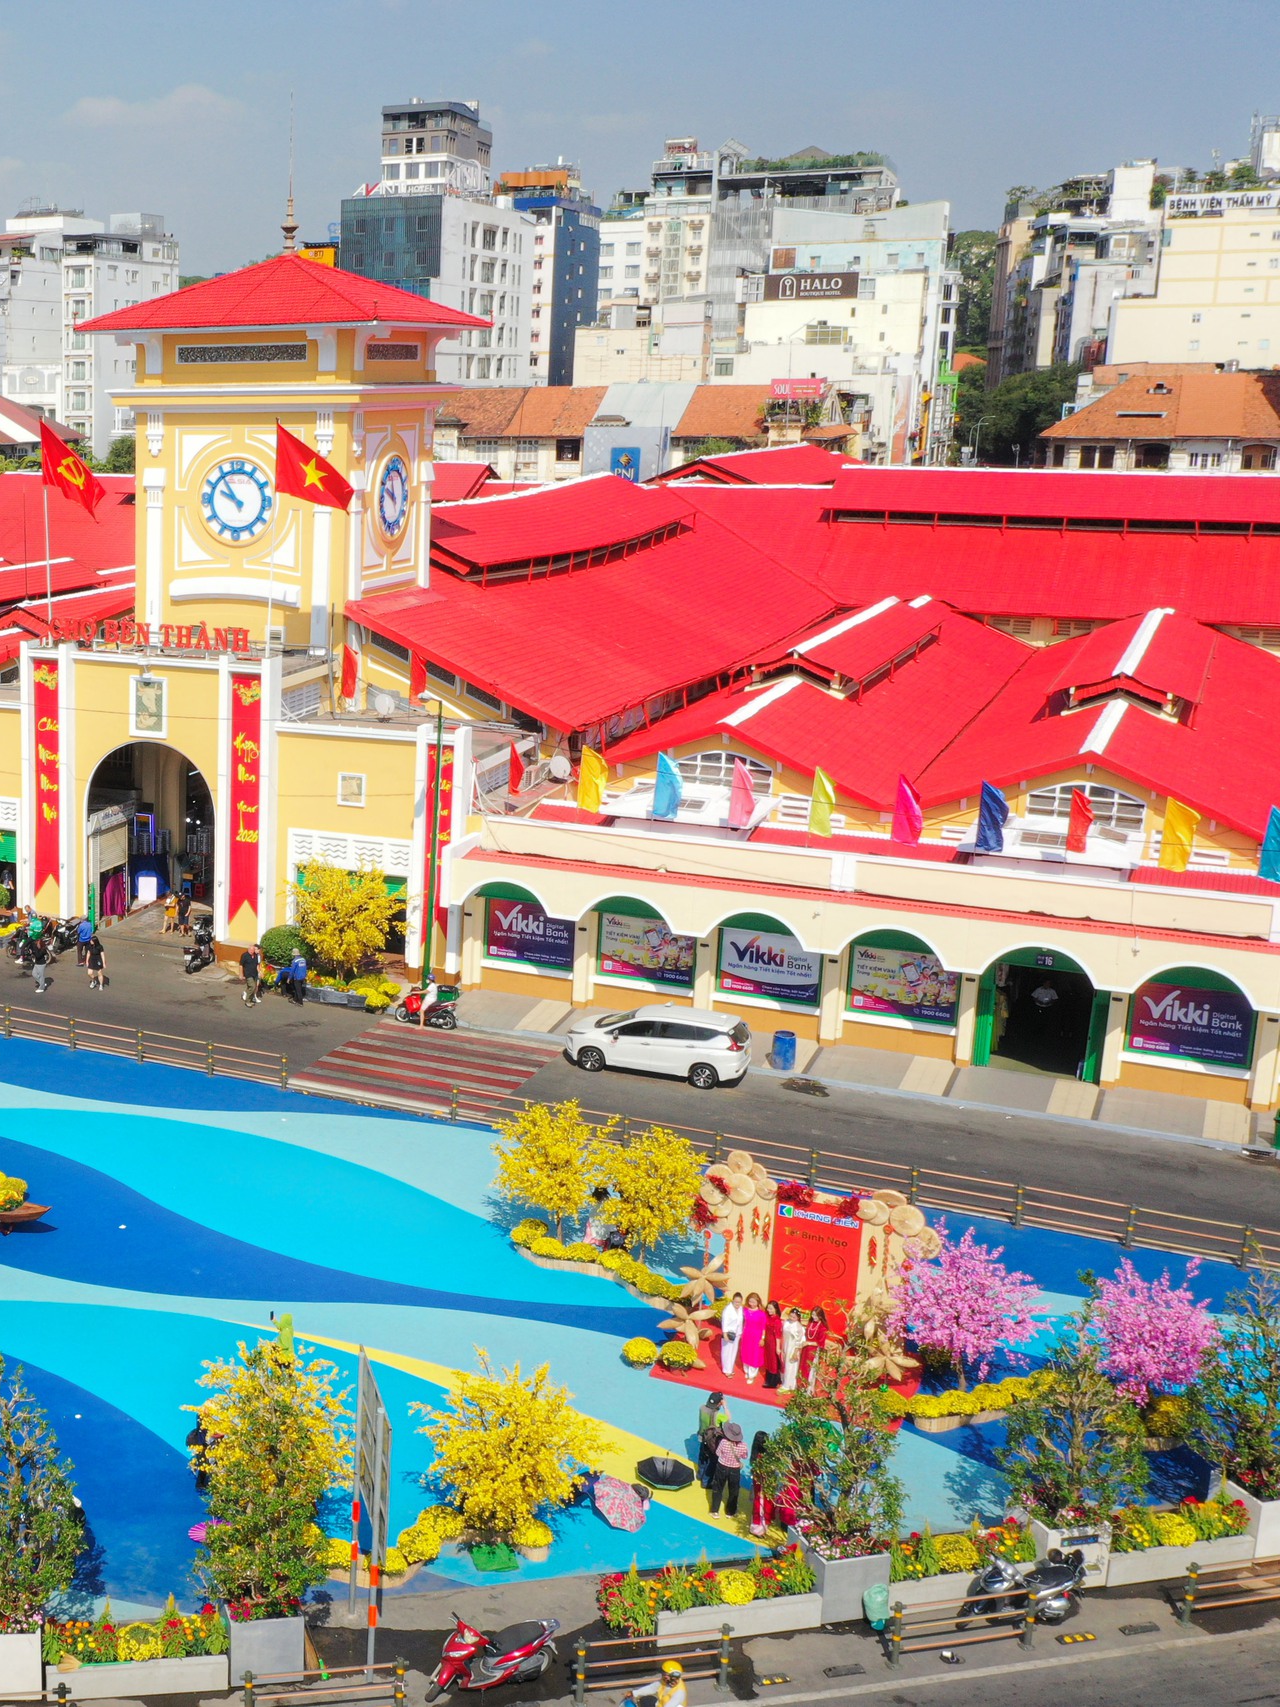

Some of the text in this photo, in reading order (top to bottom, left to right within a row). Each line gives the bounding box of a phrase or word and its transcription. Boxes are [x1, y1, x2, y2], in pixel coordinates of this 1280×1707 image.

[407, 184, 434, 193] HOTEL
[1169, 193, 1272, 211] BỆNH VIỆN THẨM MỸ
[800, 278, 842, 290] HALO
[614, 467, 635, 481] PNJ
[49, 613, 250, 653] CHỢ BẾN THÀNH
[236, 830, 258, 843] 2026
[494, 904, 544, 935] Vikki
[546, 922, 564, 930] Digital
[545, 928, 569, 938] Bank
[730, 935, 785, 967] Vikki
[787, 955, 807, 963] Digital
[1045, 956, 1053, 965] 16
[787, 961, 812, 971] Bank
[1142, 990, 1210, 1025] Vikki
[1212, 1012, 1236, 1020] Digital
[1139, 1019, 1158, 1027] Ngân
[1159, 1021, 1176, 1030] hàng
[1177, 1024, 1191, 1032] Tiết
[1211, 1018, 1243, 1031] Bank
